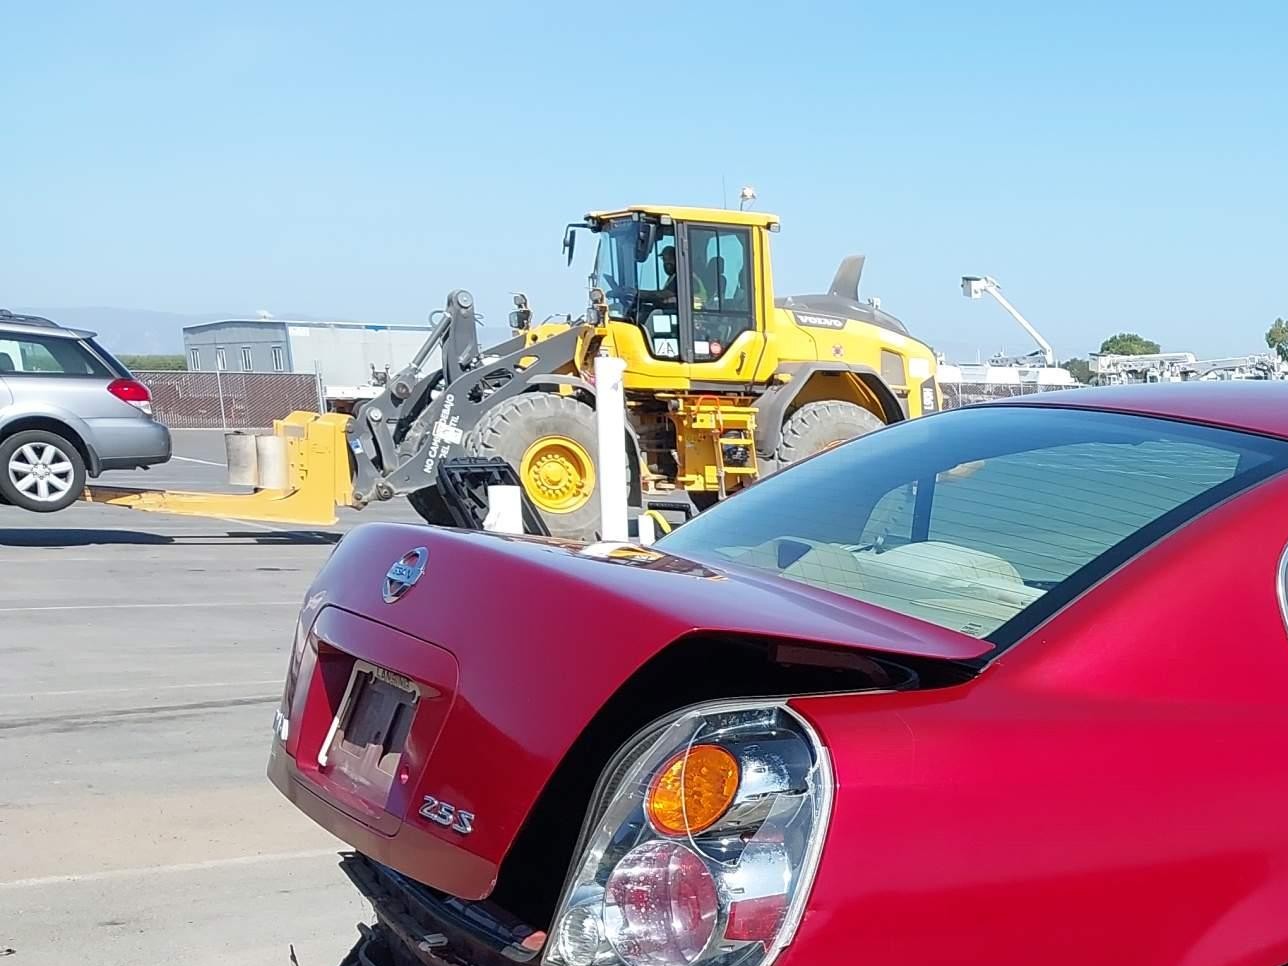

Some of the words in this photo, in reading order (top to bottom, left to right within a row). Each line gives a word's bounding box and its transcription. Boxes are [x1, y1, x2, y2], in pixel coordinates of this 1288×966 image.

[797, 314, 843, 327] VOLVO
[424, 459, 434, 474] NO
[440, 393, 455, 424] DEBAJO
